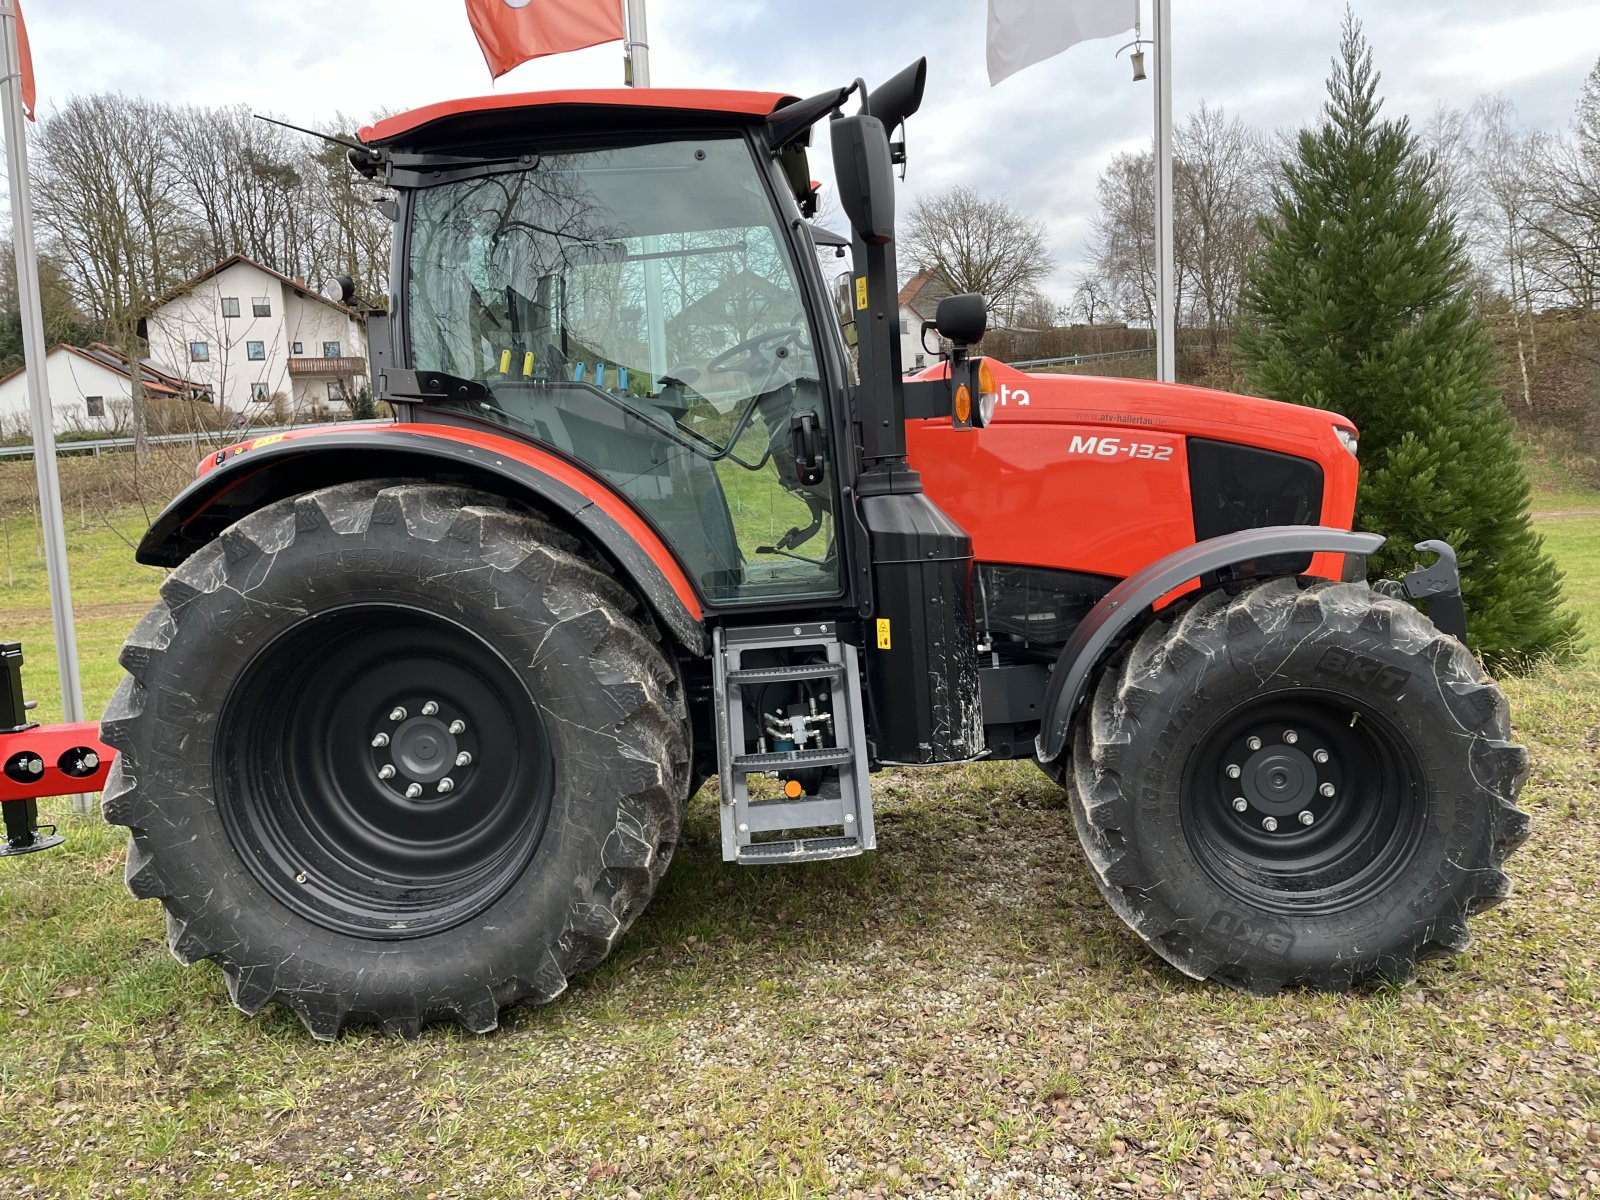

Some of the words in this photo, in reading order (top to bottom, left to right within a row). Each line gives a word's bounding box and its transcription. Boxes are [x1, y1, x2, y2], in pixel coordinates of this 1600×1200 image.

[995, 384, 1030, 406] ta
[1068, 435, 1174, 462] M6-132
[1318, 649, 1406, 691] BKT
[1202, 915, 1293, 957] BKT
